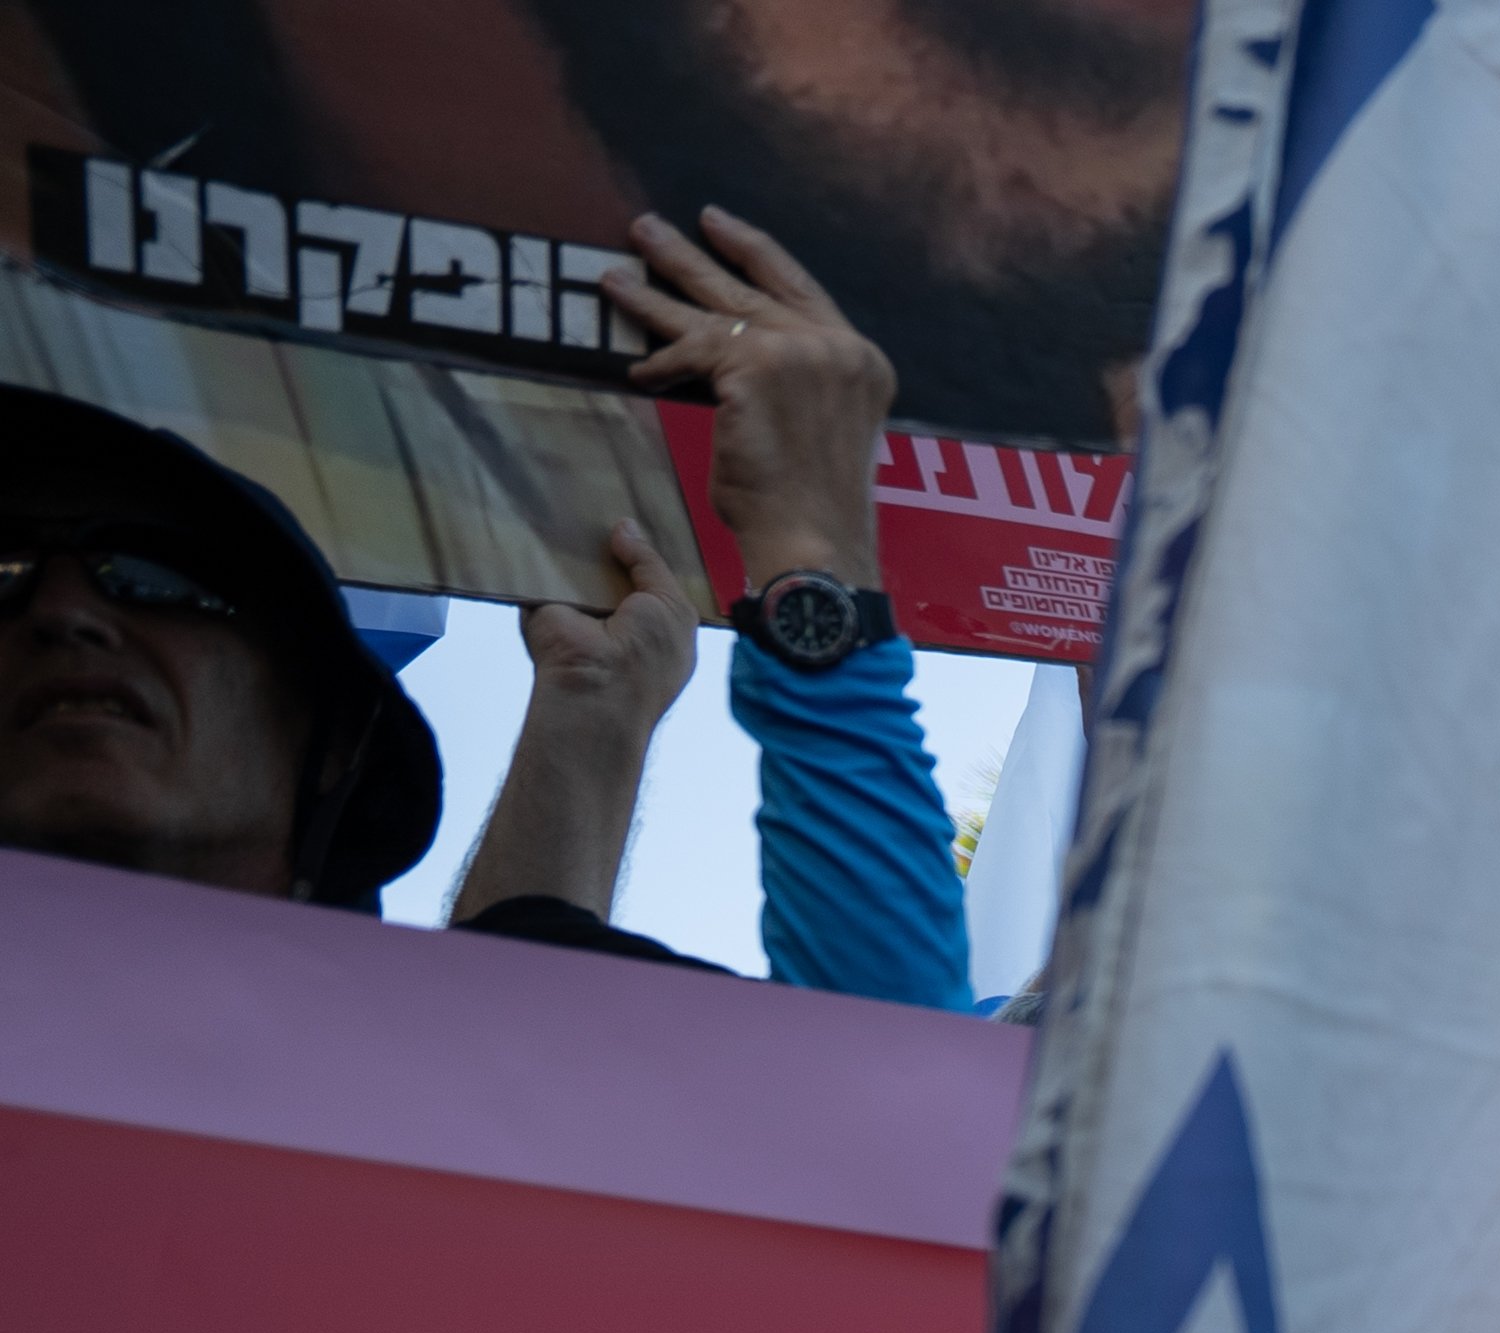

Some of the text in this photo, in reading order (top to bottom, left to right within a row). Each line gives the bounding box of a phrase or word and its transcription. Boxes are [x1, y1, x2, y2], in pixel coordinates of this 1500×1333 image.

[84, 158, 649, 356] הופקרנו
[1034, 550, 1088, 573] אלינו
[1008, 569, 1100, 597] להחזרת
[985, 589, 1092, 619] והחטופים
